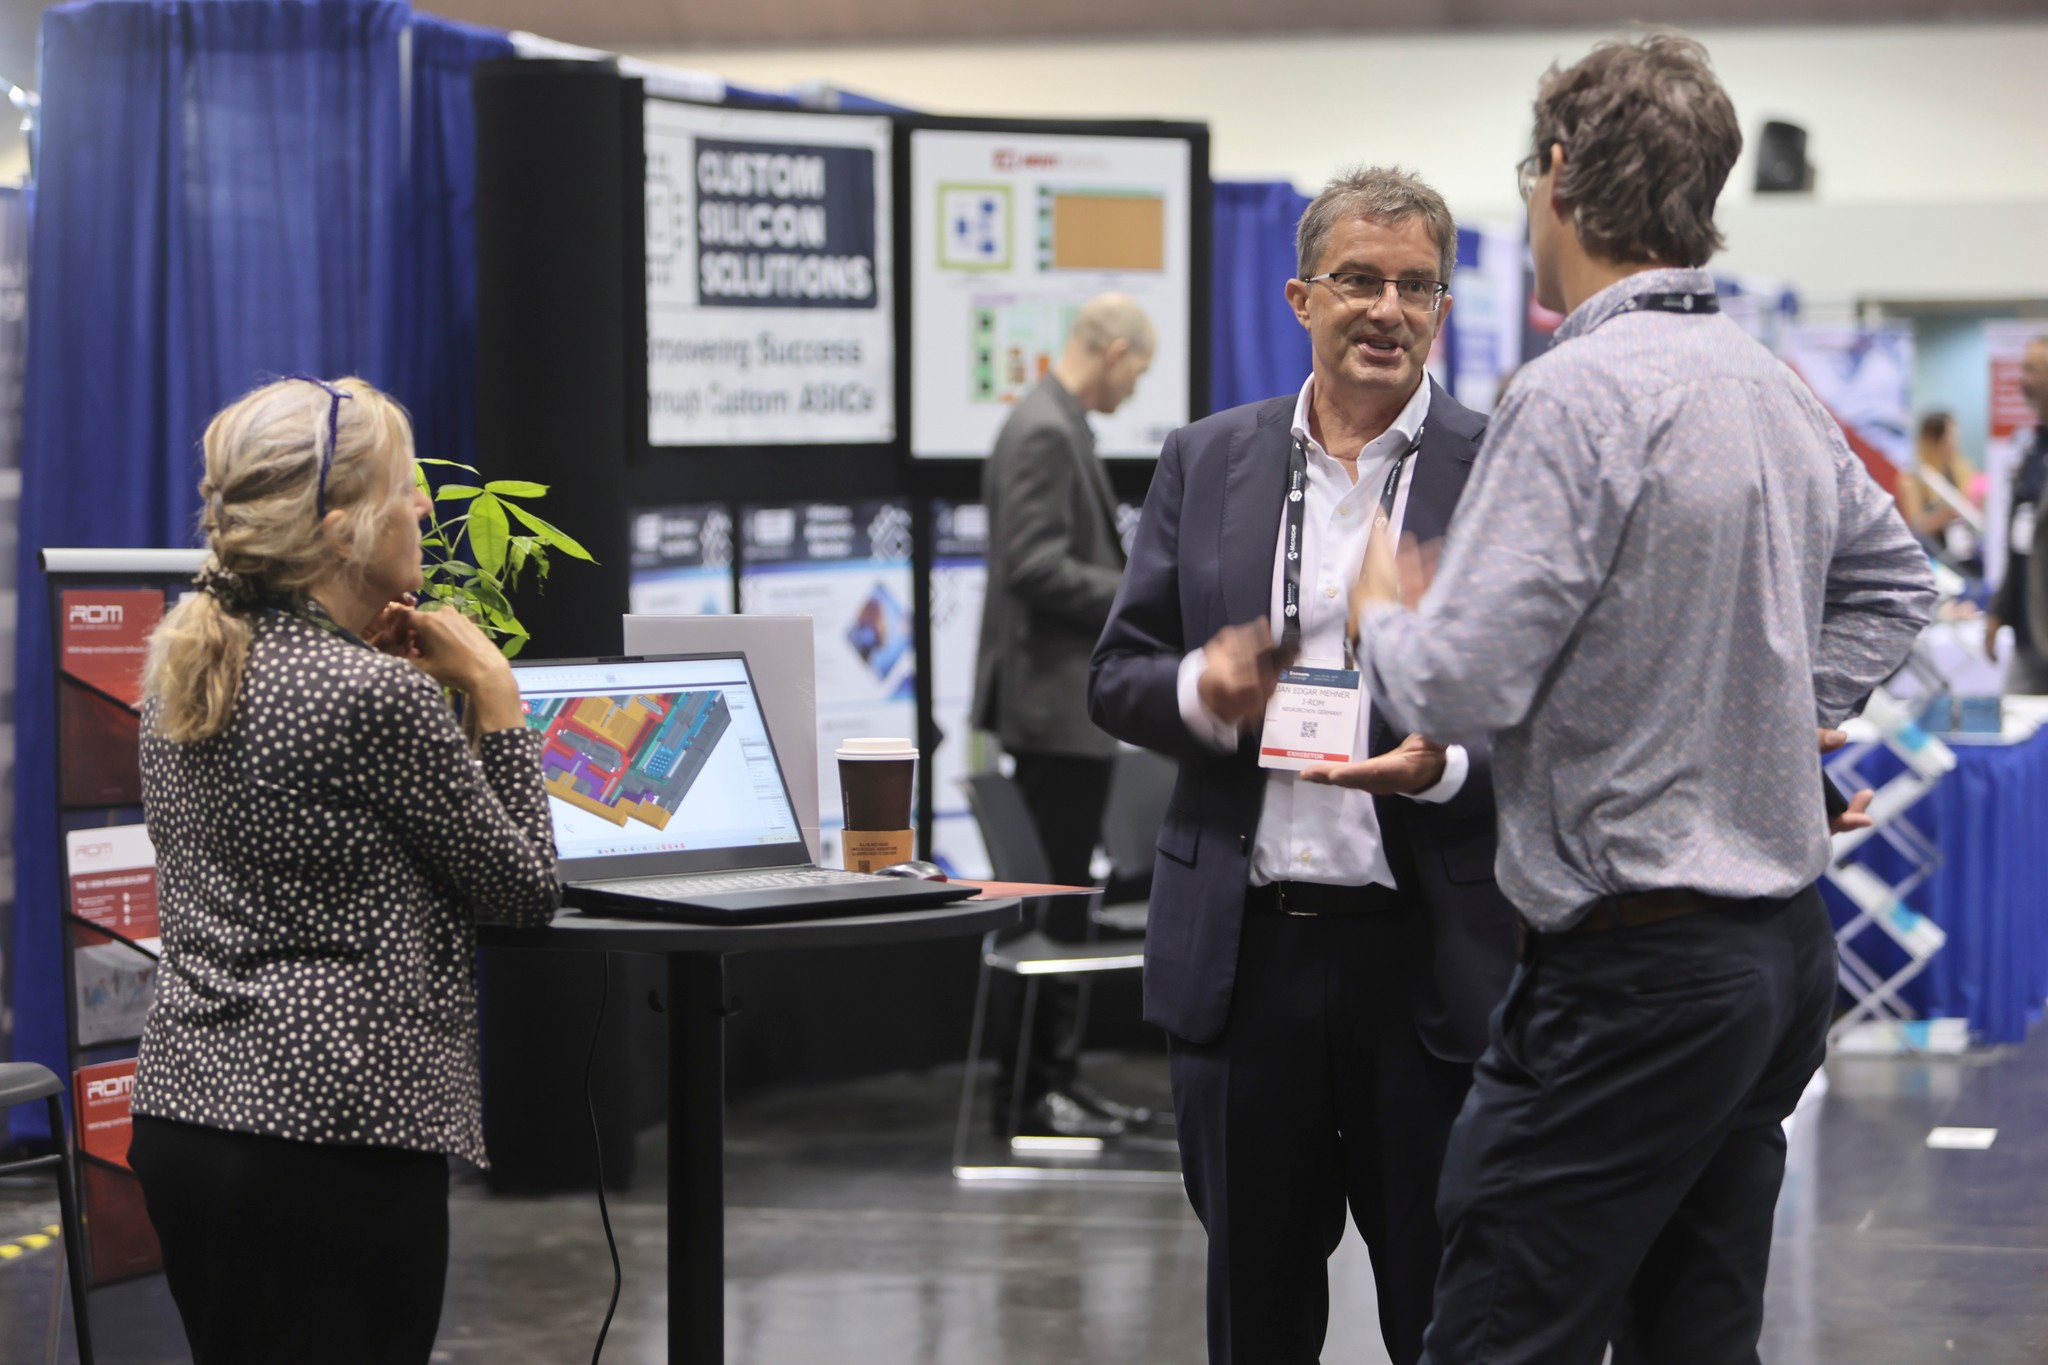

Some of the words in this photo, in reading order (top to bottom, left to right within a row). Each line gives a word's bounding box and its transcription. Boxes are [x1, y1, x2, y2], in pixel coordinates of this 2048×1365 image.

[698, 150, 826, 198] CUSTOM
[699, 200, 827, 249] SILICON
[700, 251, 873, 298] SOLUTIONS
[757, 330, 863, 364] Success
[705, 380, 787, 415] Custom
[798, 381, 877, 413] ASICs
[1276, 685, 1291, 693] JAN
[1293, 687, 1317, 696] EDGAR
[1319, 689, 1350, 699] MEHNER
[1286, 750, 1324, 760] EXHIBITOR
